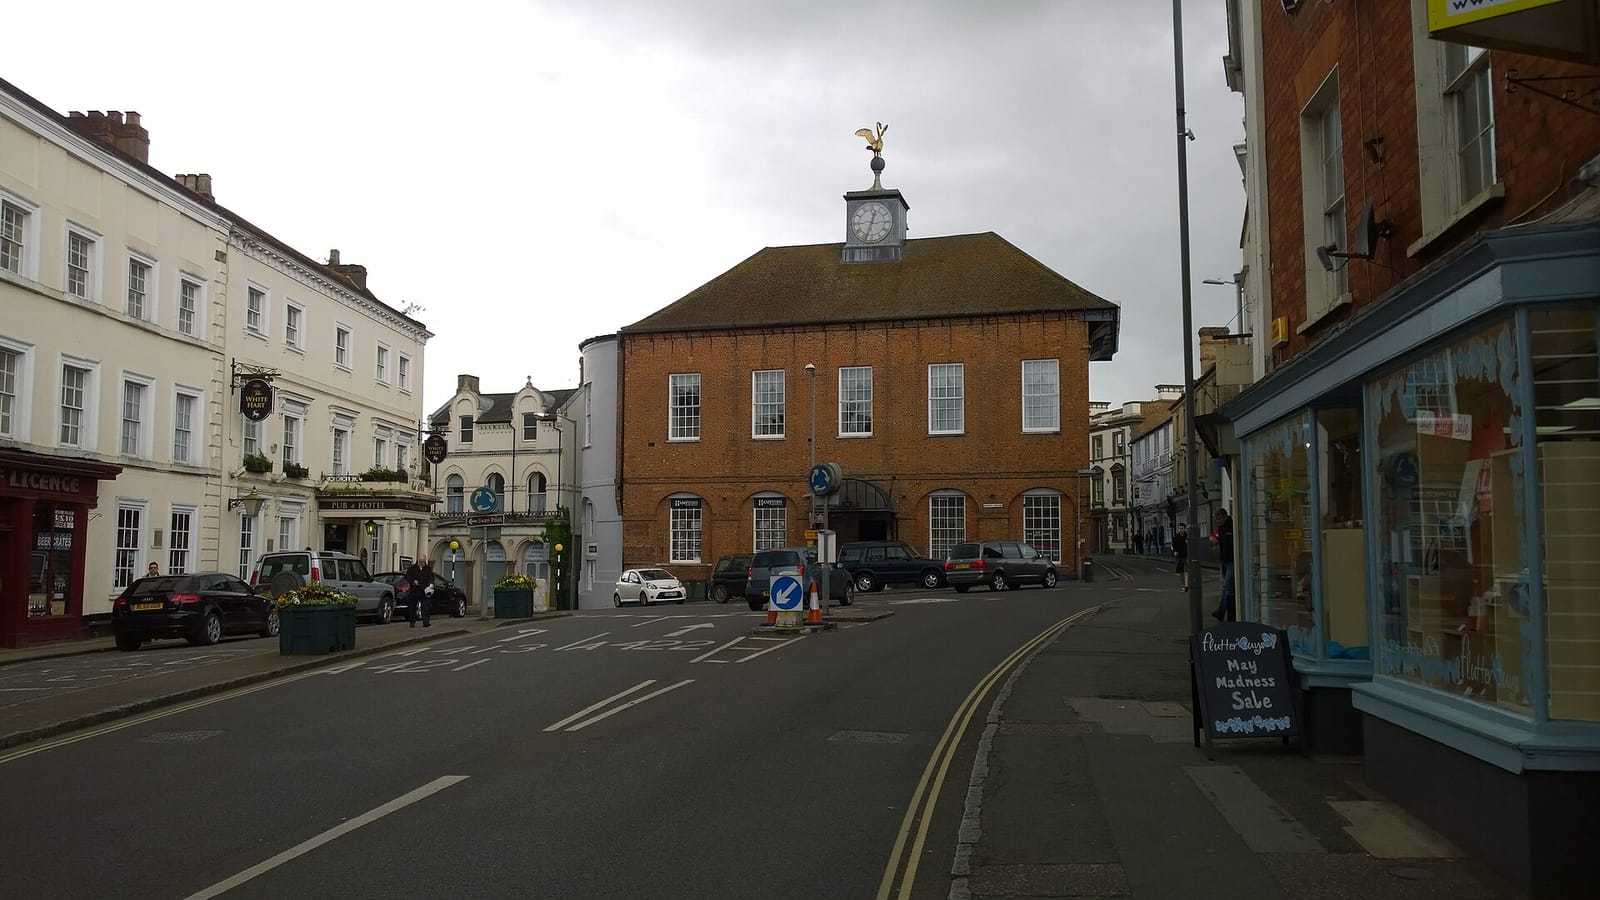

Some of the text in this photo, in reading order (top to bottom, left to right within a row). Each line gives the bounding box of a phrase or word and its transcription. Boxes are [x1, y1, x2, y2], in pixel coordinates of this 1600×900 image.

[9, 470, 80, 493] LICENCE
[331, 501, 348, 509] PUB
[358, 501, 385, 509] HOTEL
[1227, 659, 1257, 674] May
[1215, 674, 1275, 688] Madness
[1232, 690, 1273, 710] Sale
